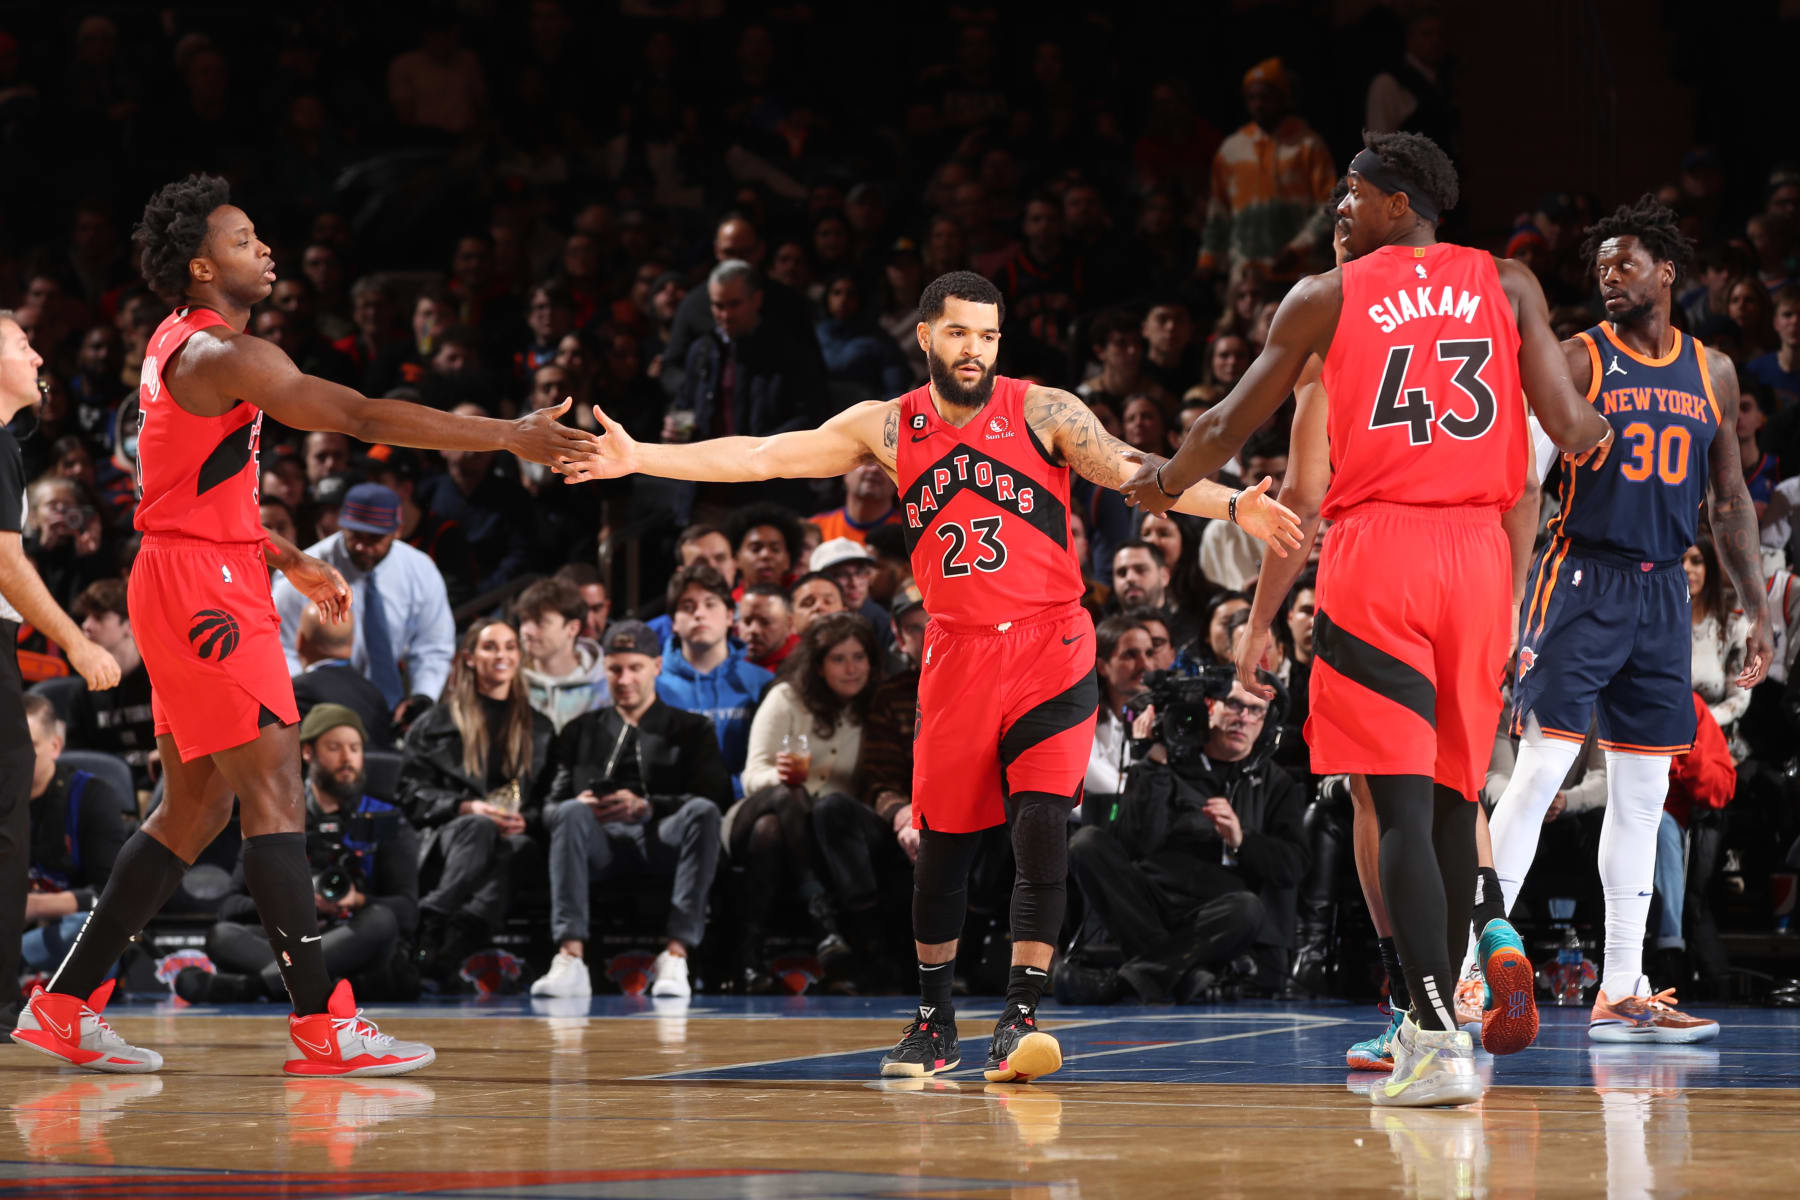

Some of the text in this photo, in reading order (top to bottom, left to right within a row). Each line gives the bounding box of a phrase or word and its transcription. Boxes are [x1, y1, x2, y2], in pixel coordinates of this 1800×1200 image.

[1368, 286, 1481, 334] SIAKAM
[1368, 338, 1497, 446] 43
[1603, 387, 1707, 424] NEW YORK
[913, 415, 923, 429] 6
[985, 430, 1015, 441] Sun Life
[1620, 422, 1692, 485] 30
[906, 455, 1034, 528] RAPTORS
[936, 516, 1007, 578] 23
